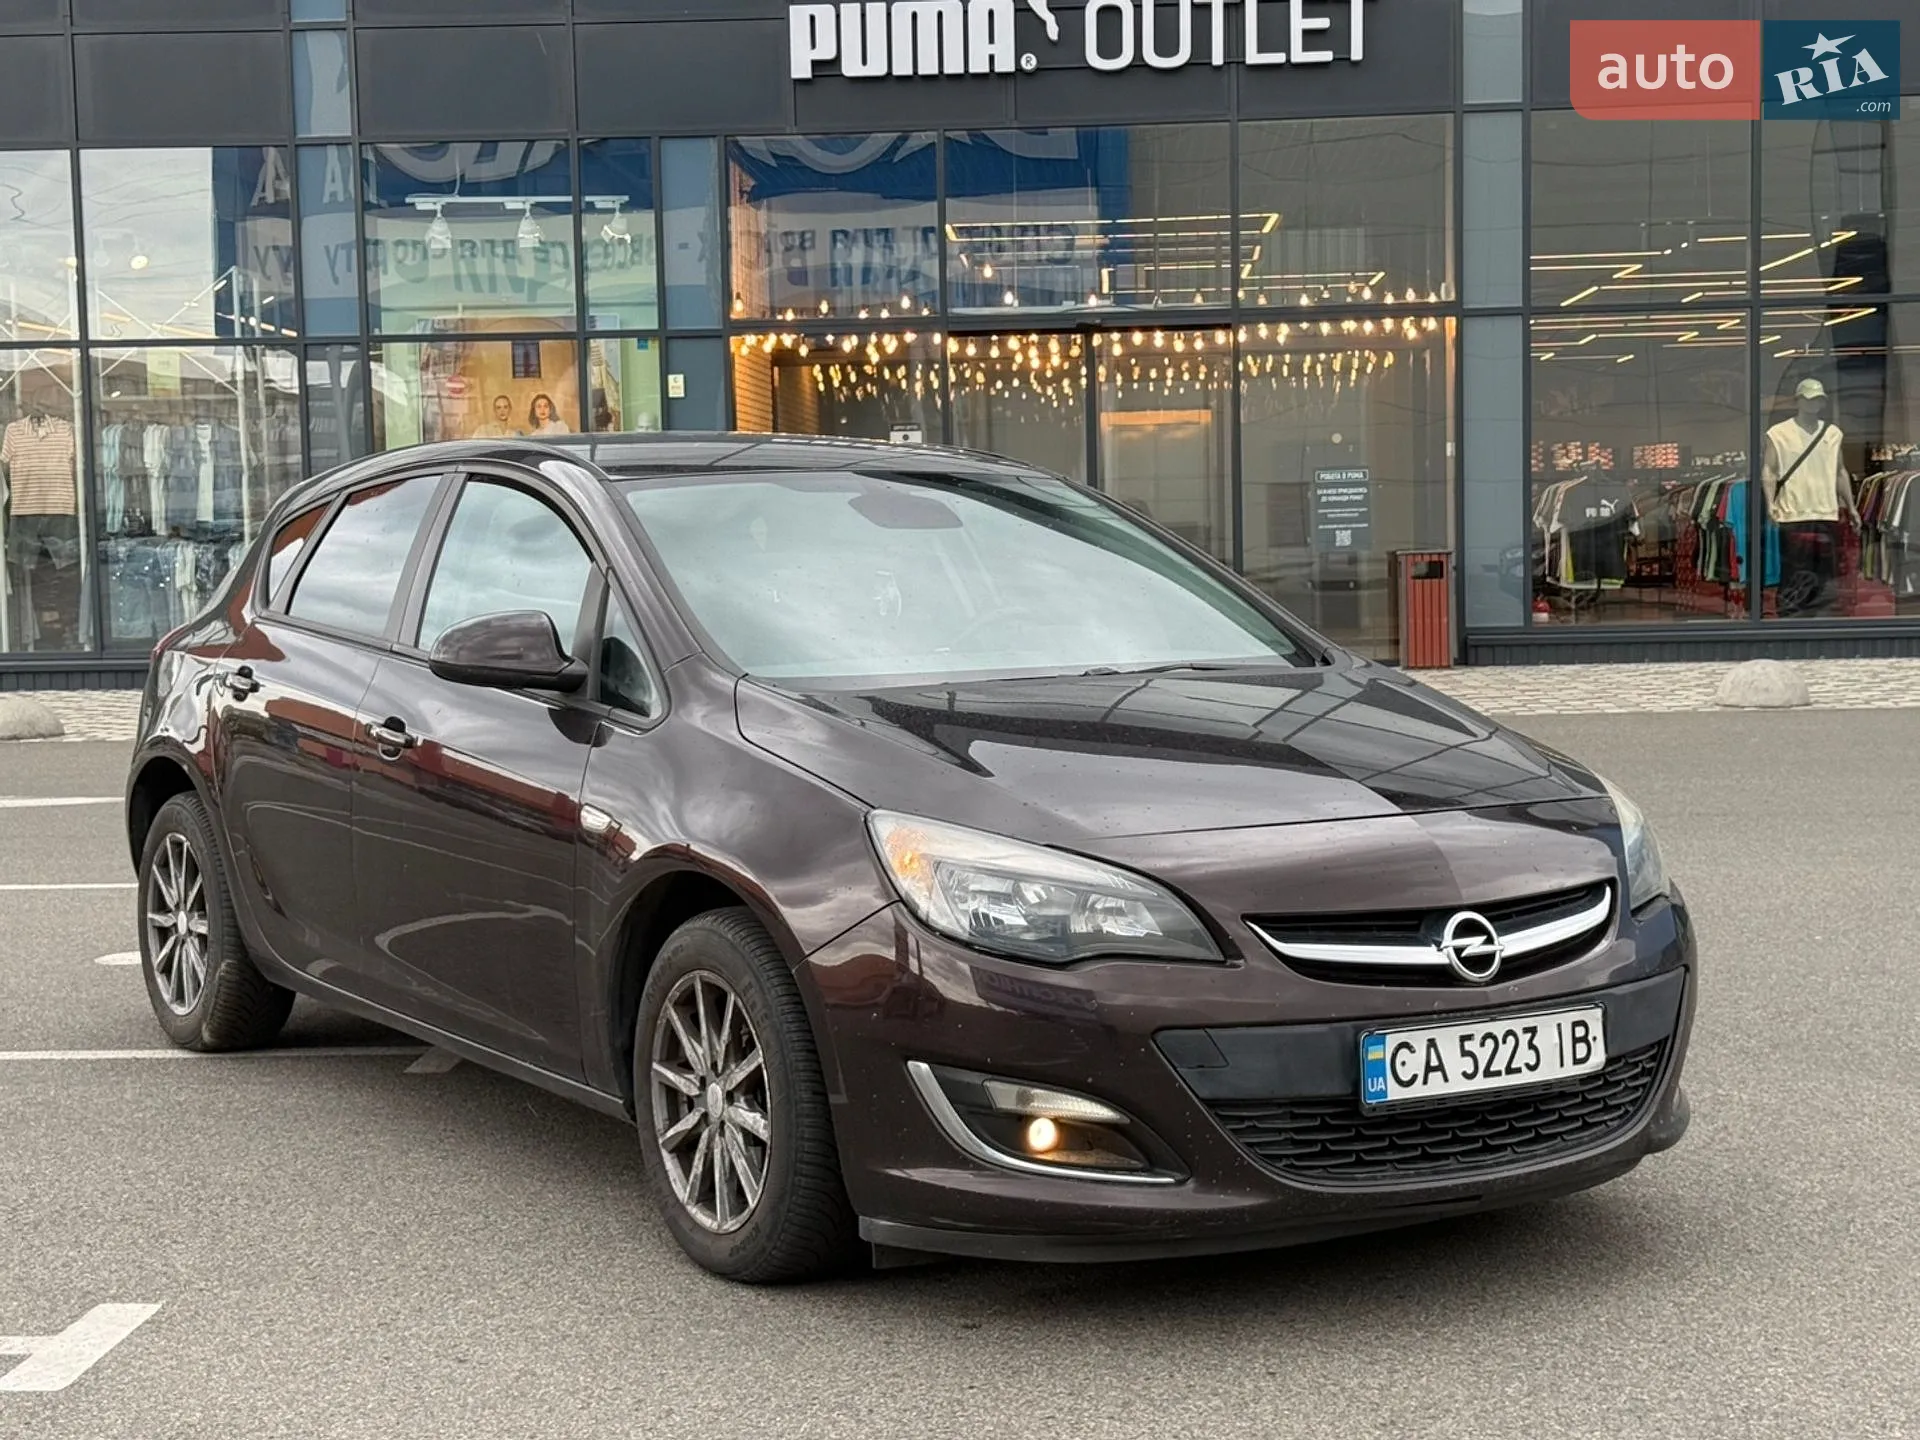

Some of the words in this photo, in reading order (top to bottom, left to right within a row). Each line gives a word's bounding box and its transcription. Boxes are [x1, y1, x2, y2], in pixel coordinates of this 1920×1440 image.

[789, 0, 1015, 78] PUMA
[1084, 0, 1363, 70] OUTLET
[1368, 1076, 1386, 1092] UA
[1390, 1037, 1449, 1088] CA
[1458, 1025, 1541, 1080] 5223
[1557, 1020, 1593, 1068] IB
